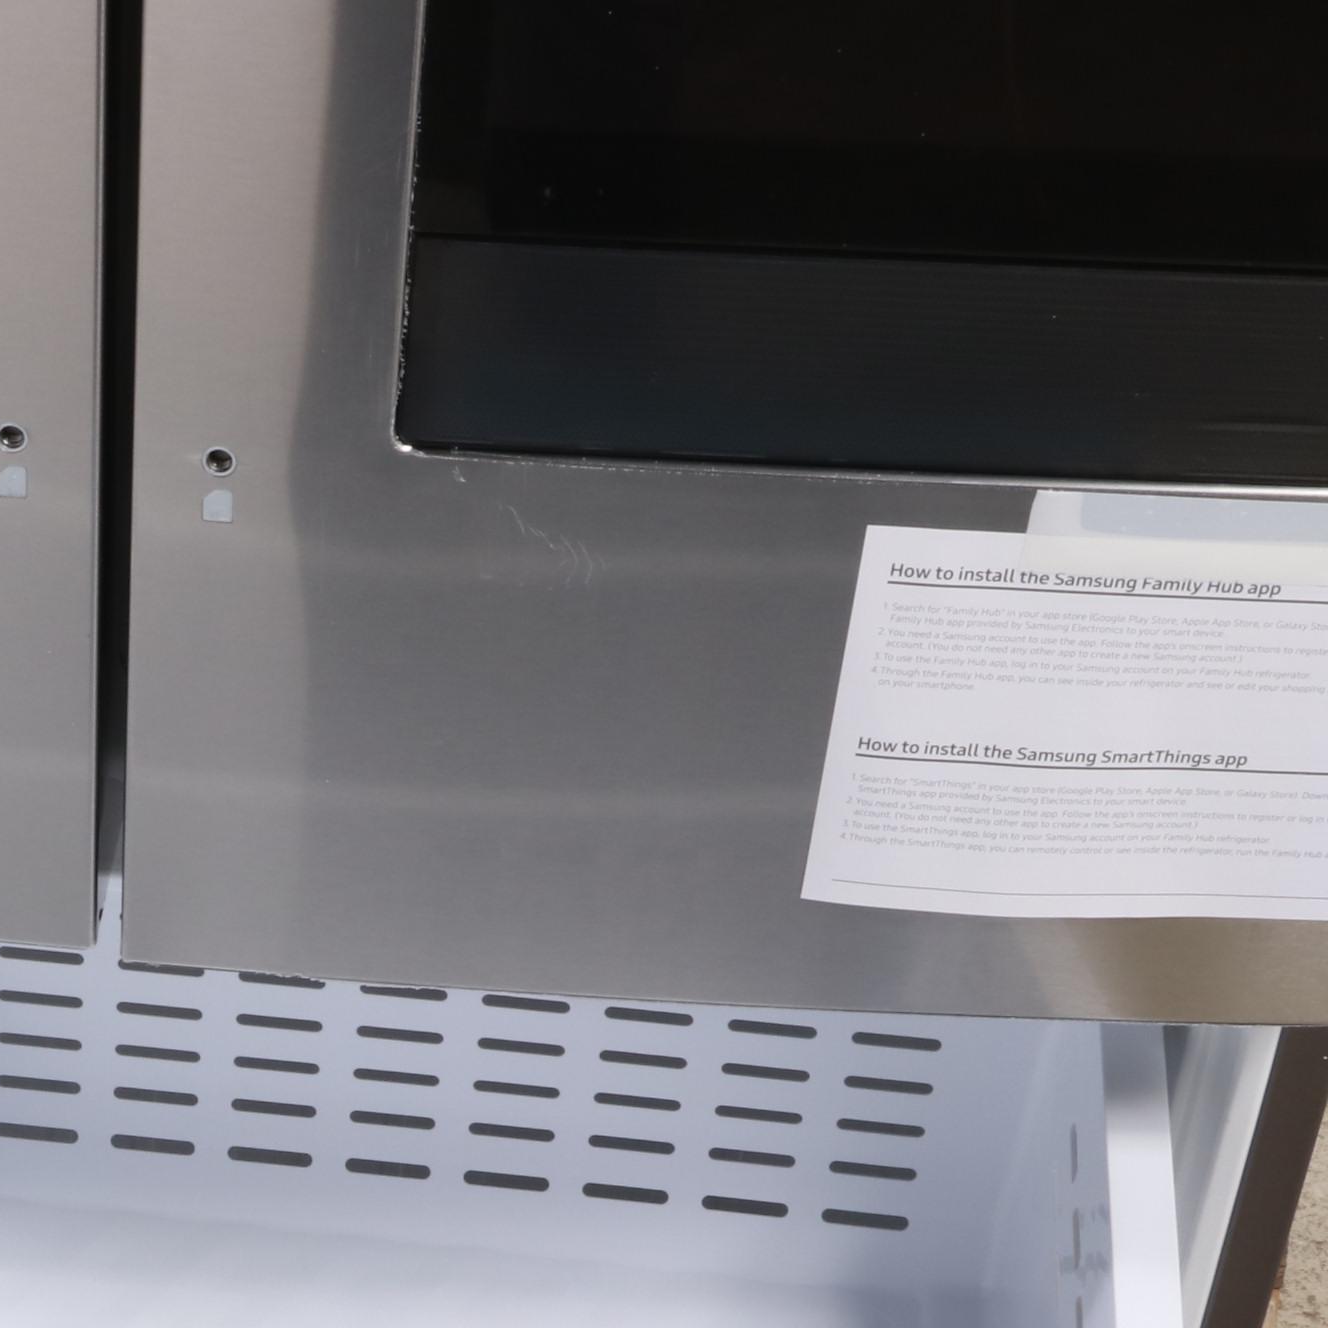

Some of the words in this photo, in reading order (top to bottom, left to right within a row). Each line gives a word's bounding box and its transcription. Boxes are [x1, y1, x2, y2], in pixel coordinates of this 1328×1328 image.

[888, 562, 932, 578] How
[933, 565, 955, 580] to
[956, 566, 1016, 583] install
[1016, 569, 1051, 584] the
[1051, 570, 1139, 592] Samsung
[1140, 574, 1204, 595] Family
[1205, 577, 1246, 593] Hub
[1246, 582, 1283, 598] app
[855, 736, 897, 752] How
[900, 739, 921, 753] to
[922, 740, 980, 757] install
[981, 743, 1014, 758] the
[1015, 745, 1098, 766] Samsung
[1099, 748, 1212, 768] SmartThings
[1213, 754, 1249, 769] app
